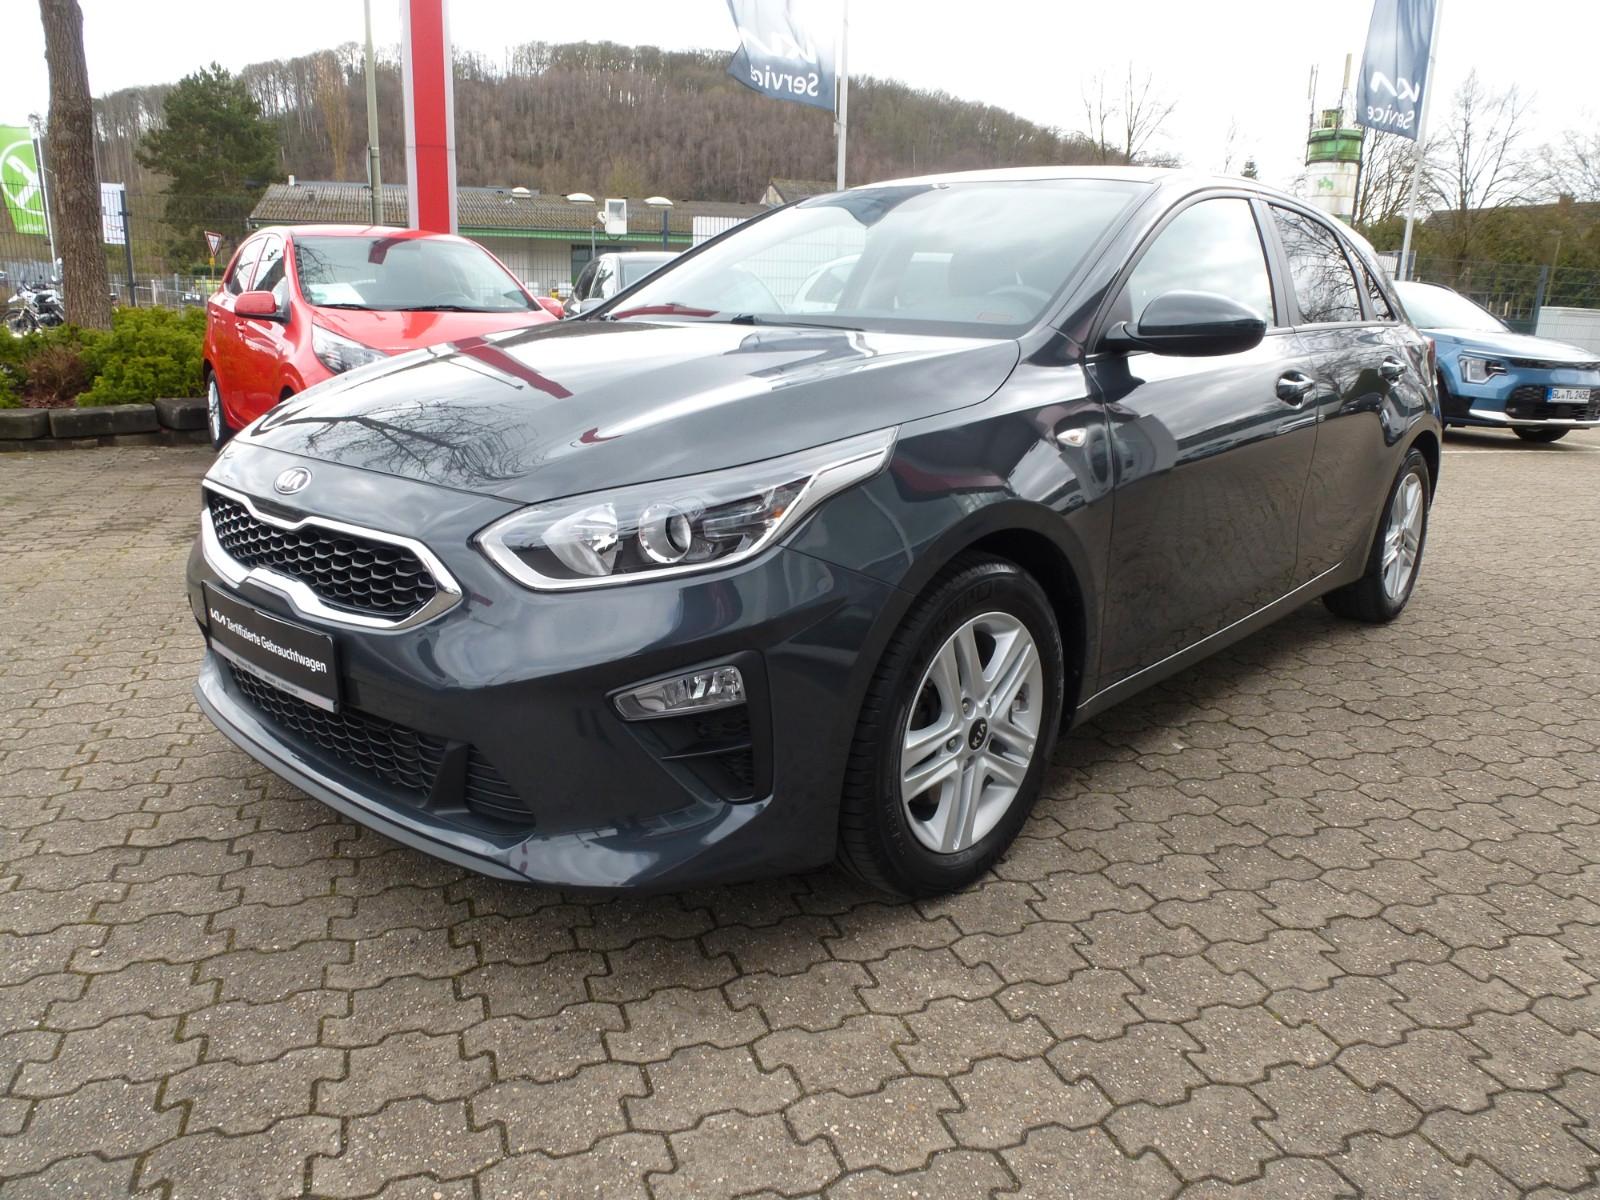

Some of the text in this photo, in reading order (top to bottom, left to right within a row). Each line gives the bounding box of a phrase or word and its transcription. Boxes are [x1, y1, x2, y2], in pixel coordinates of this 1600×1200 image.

[226, 617, 261, 646] Zertifizierte
[261, 635, 327, 673] Gebrauchtwagen
[972, 723, 986, 748] KIA
